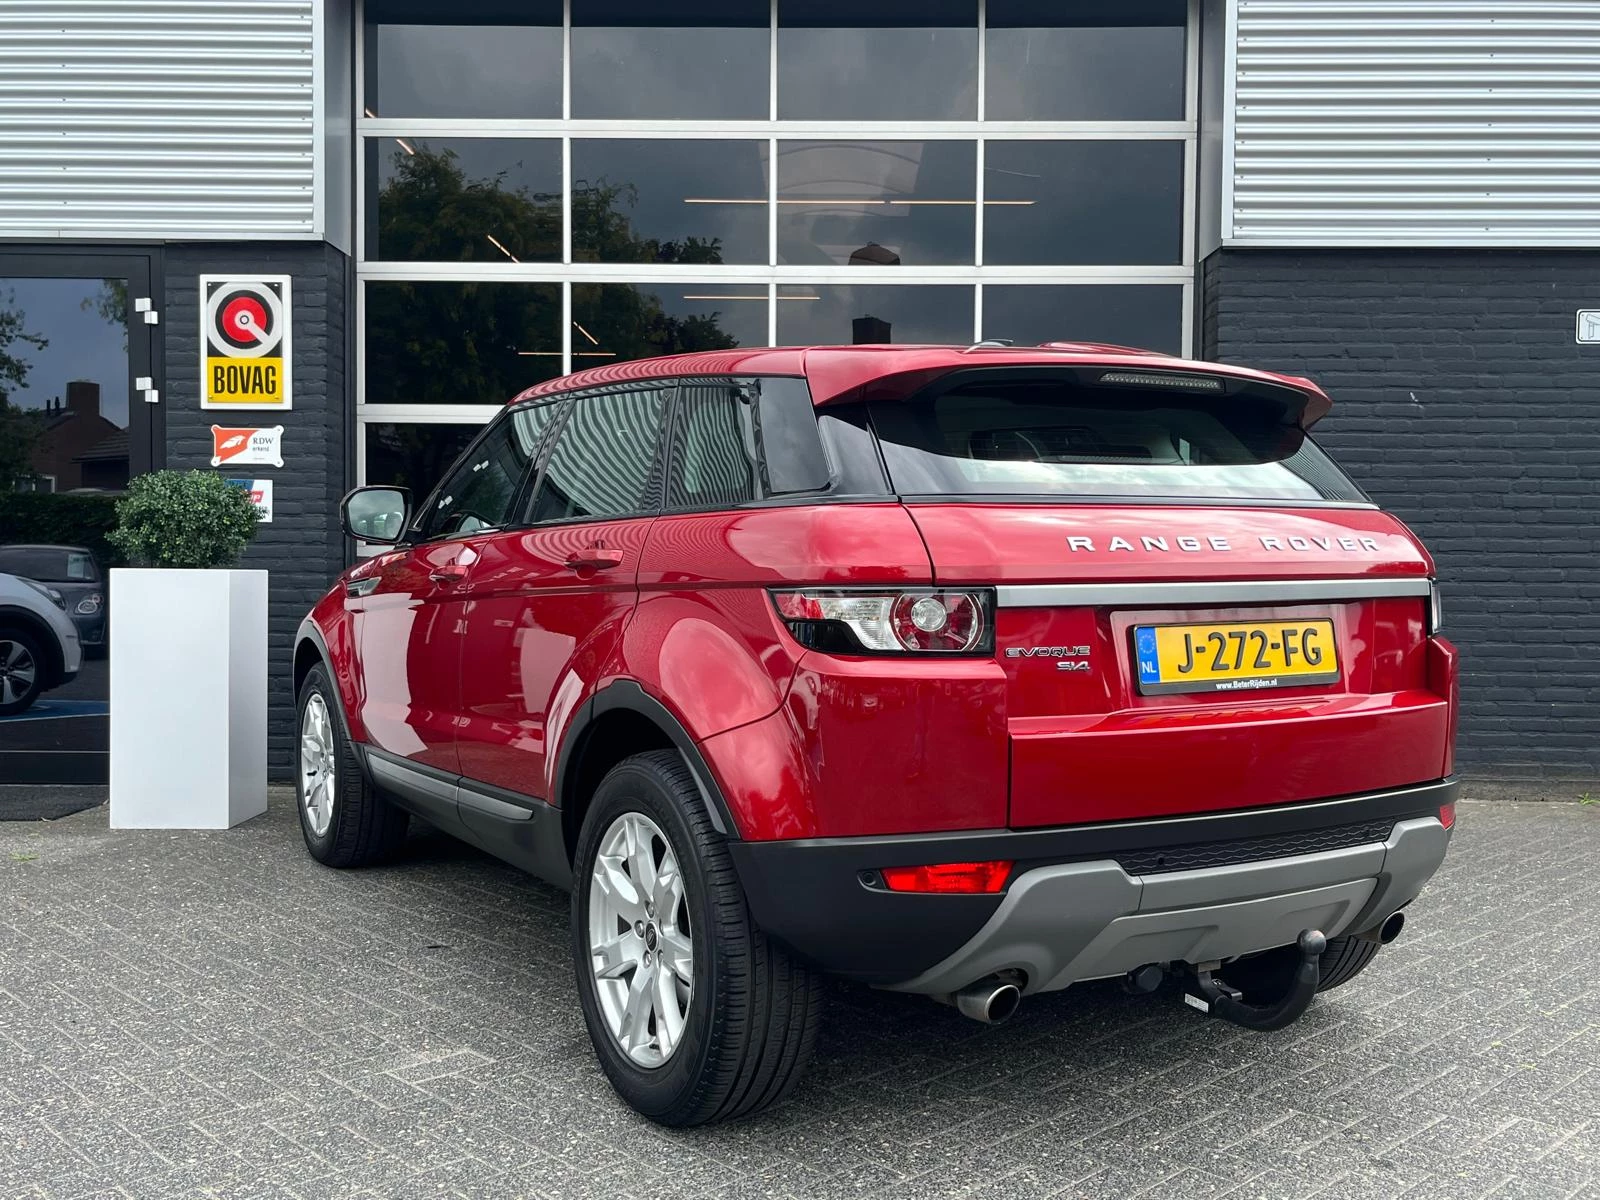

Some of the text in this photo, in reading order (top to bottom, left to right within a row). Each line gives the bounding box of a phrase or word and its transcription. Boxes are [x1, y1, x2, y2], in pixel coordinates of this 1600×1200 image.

[214, 365, 276, 394] BOVAG
[253, 437, 274, 445] RDW
[1066, 536, 1380, 552] RANGE ROVER
[1005, 645, 1091, 658] EVOQUE
[1178, 628, 1322, 673] J-272-FG
[1141, 661, 1157, 673] NL
